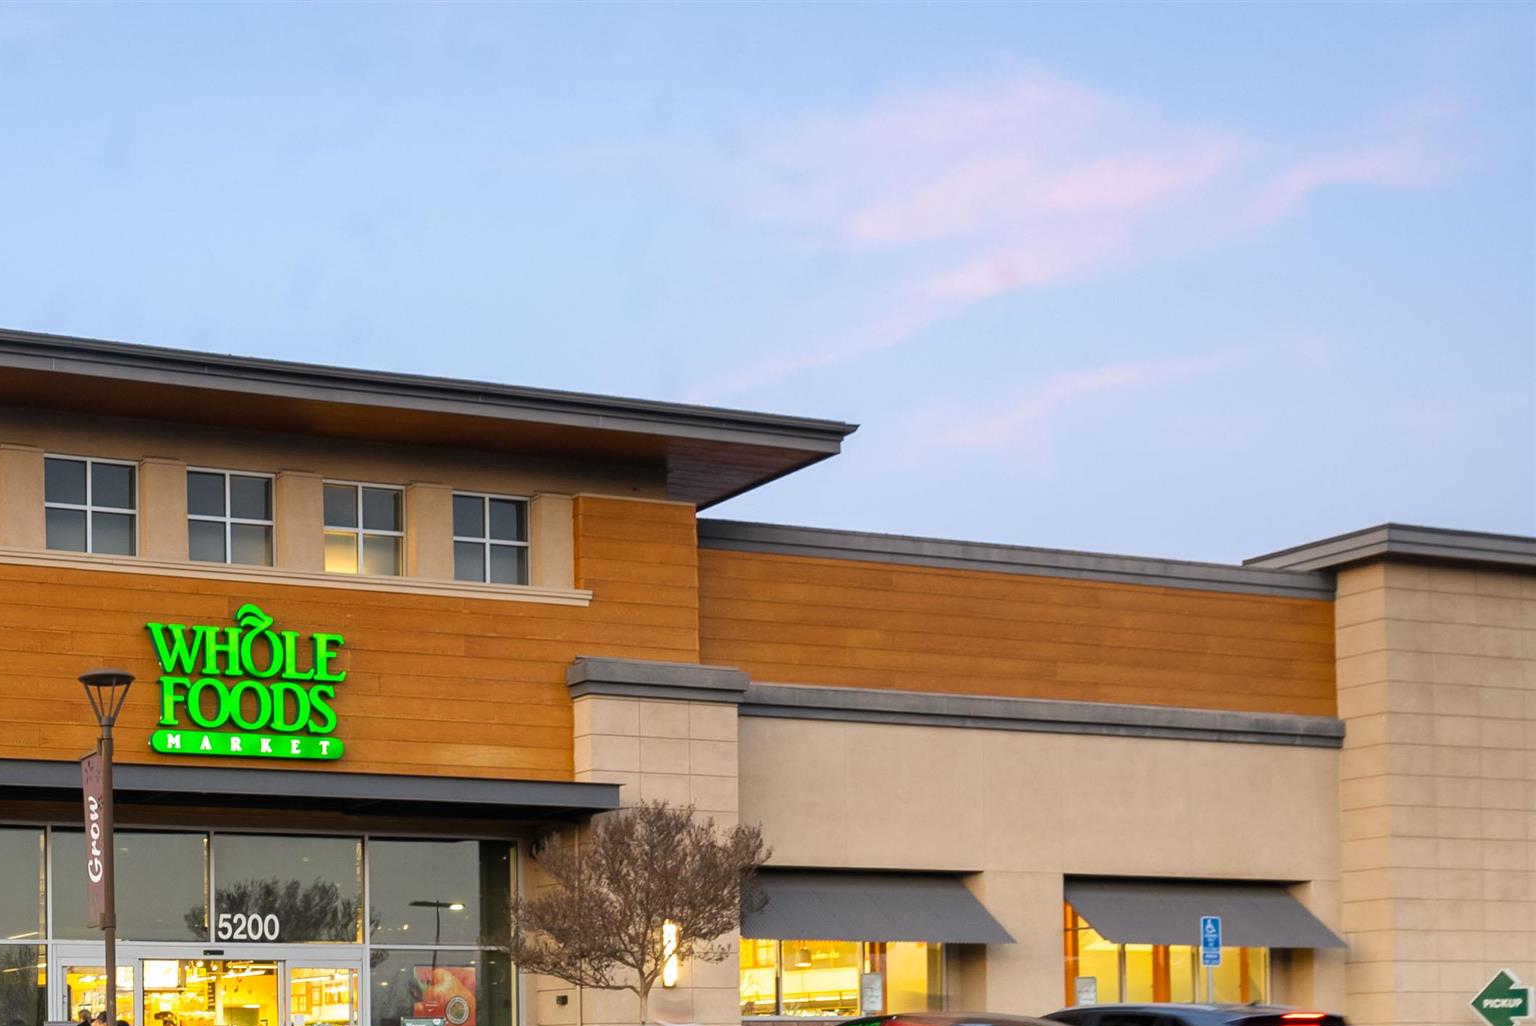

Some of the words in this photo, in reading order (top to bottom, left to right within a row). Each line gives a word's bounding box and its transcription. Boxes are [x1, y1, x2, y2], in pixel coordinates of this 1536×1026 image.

[146, 606, 346, 682] WHOLE
[159, 676, 337, 734] FOODS
[167, 734, 330, 756] MARKET
[88, 795, 103, 883] Grow
[217, 913, 280, 940] 5200
[1483, 998, 1523, 1008] PICKUP
